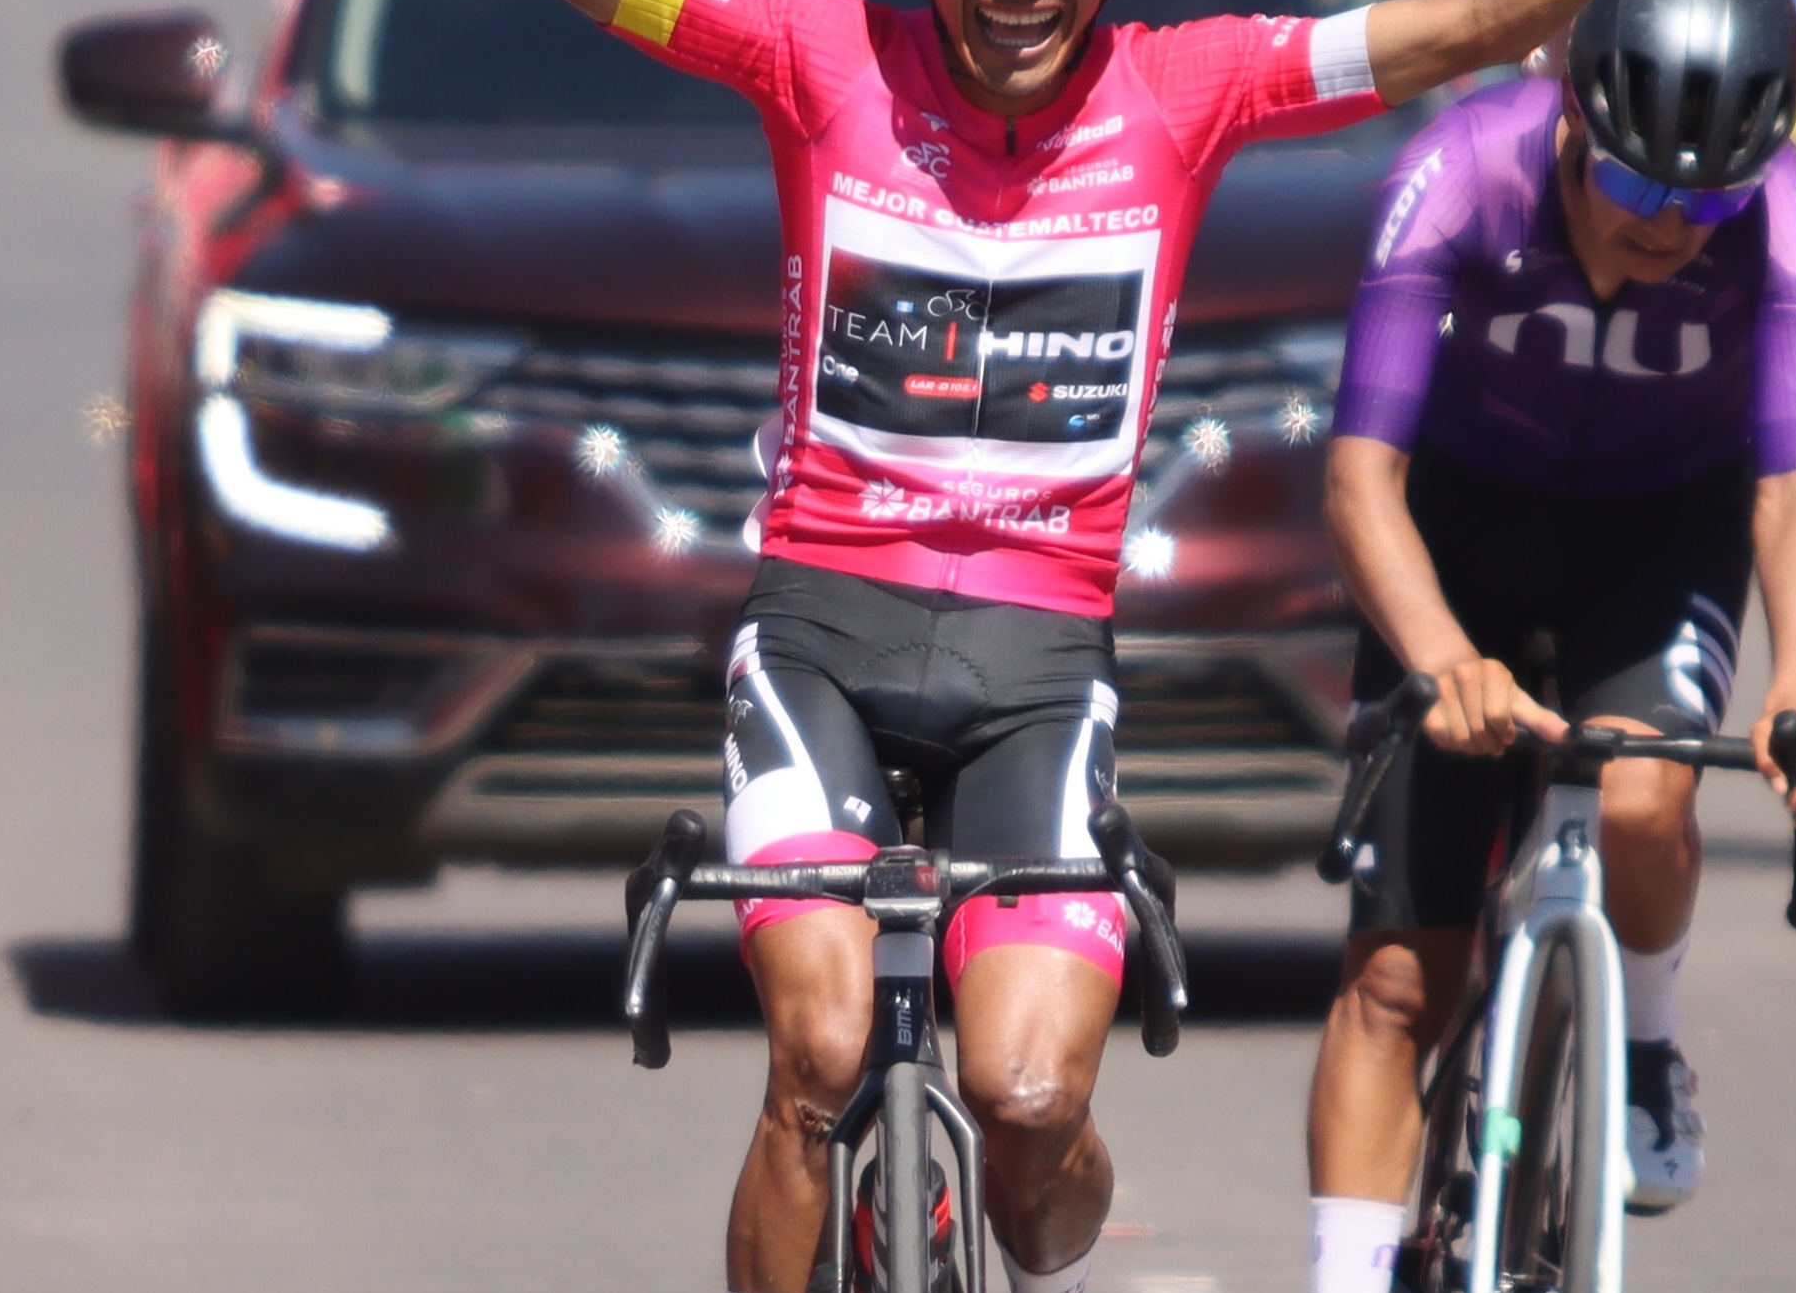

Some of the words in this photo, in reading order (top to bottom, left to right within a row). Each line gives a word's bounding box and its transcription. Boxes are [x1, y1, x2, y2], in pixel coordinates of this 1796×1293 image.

[1048, 164, 1134, 194] BANTRAB
[833, 171, 926, 220] MEJOR
[934, 203, 1159, 238] GUATEMALTECO
[1375, 148, 1442, 269] SCOTT
[827, 304, 928, 350] TEAM
[979, 329, 1135, 359] HINO
[1488, 302, 1712, 376] nu
[784, 254, 803, 446] BANTRAB
[822, 355, 860, 382] One
[1052, 383, 1127, 400] SUZUKI
[942, 480, 1053, 502] SEGUROS
[907, 496, 1071, 534] BANTRAB
